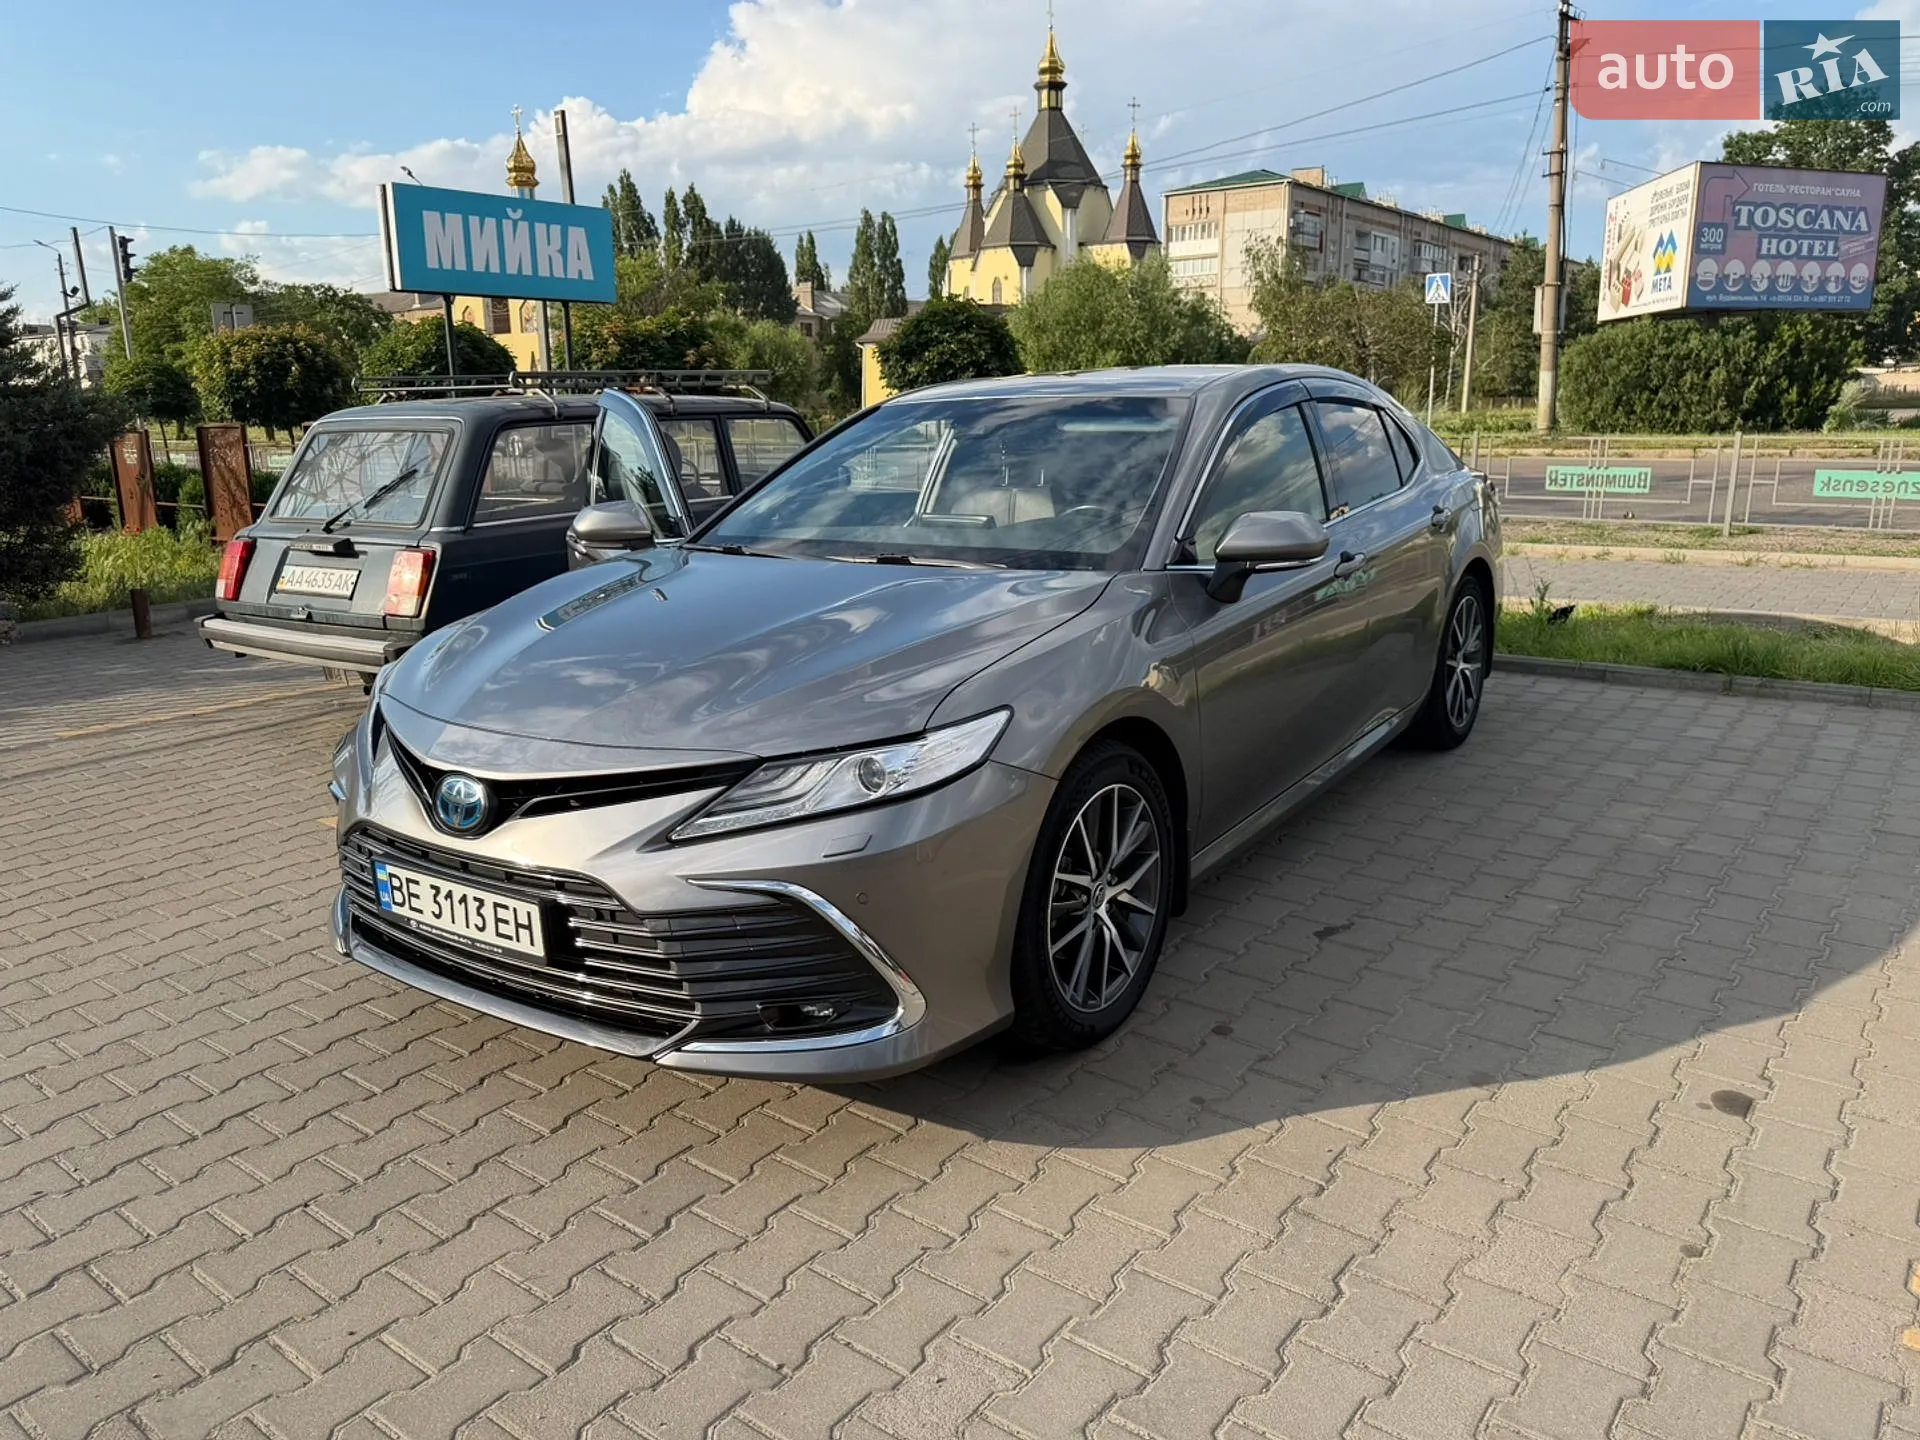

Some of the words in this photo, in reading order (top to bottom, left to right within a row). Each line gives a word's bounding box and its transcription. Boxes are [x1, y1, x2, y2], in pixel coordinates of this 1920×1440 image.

[1735, 205, 1869, 232] TOSCANA
[422, 207, 594, 281] МИЙКА
[1701, 227, 1724, 243] 300
[1759, 238, 1839, 257] HOTEL
[388, 872, 424, 915] BE
[429, 884, 487, 933] 3113
[492, 901, 535, 947] EH
